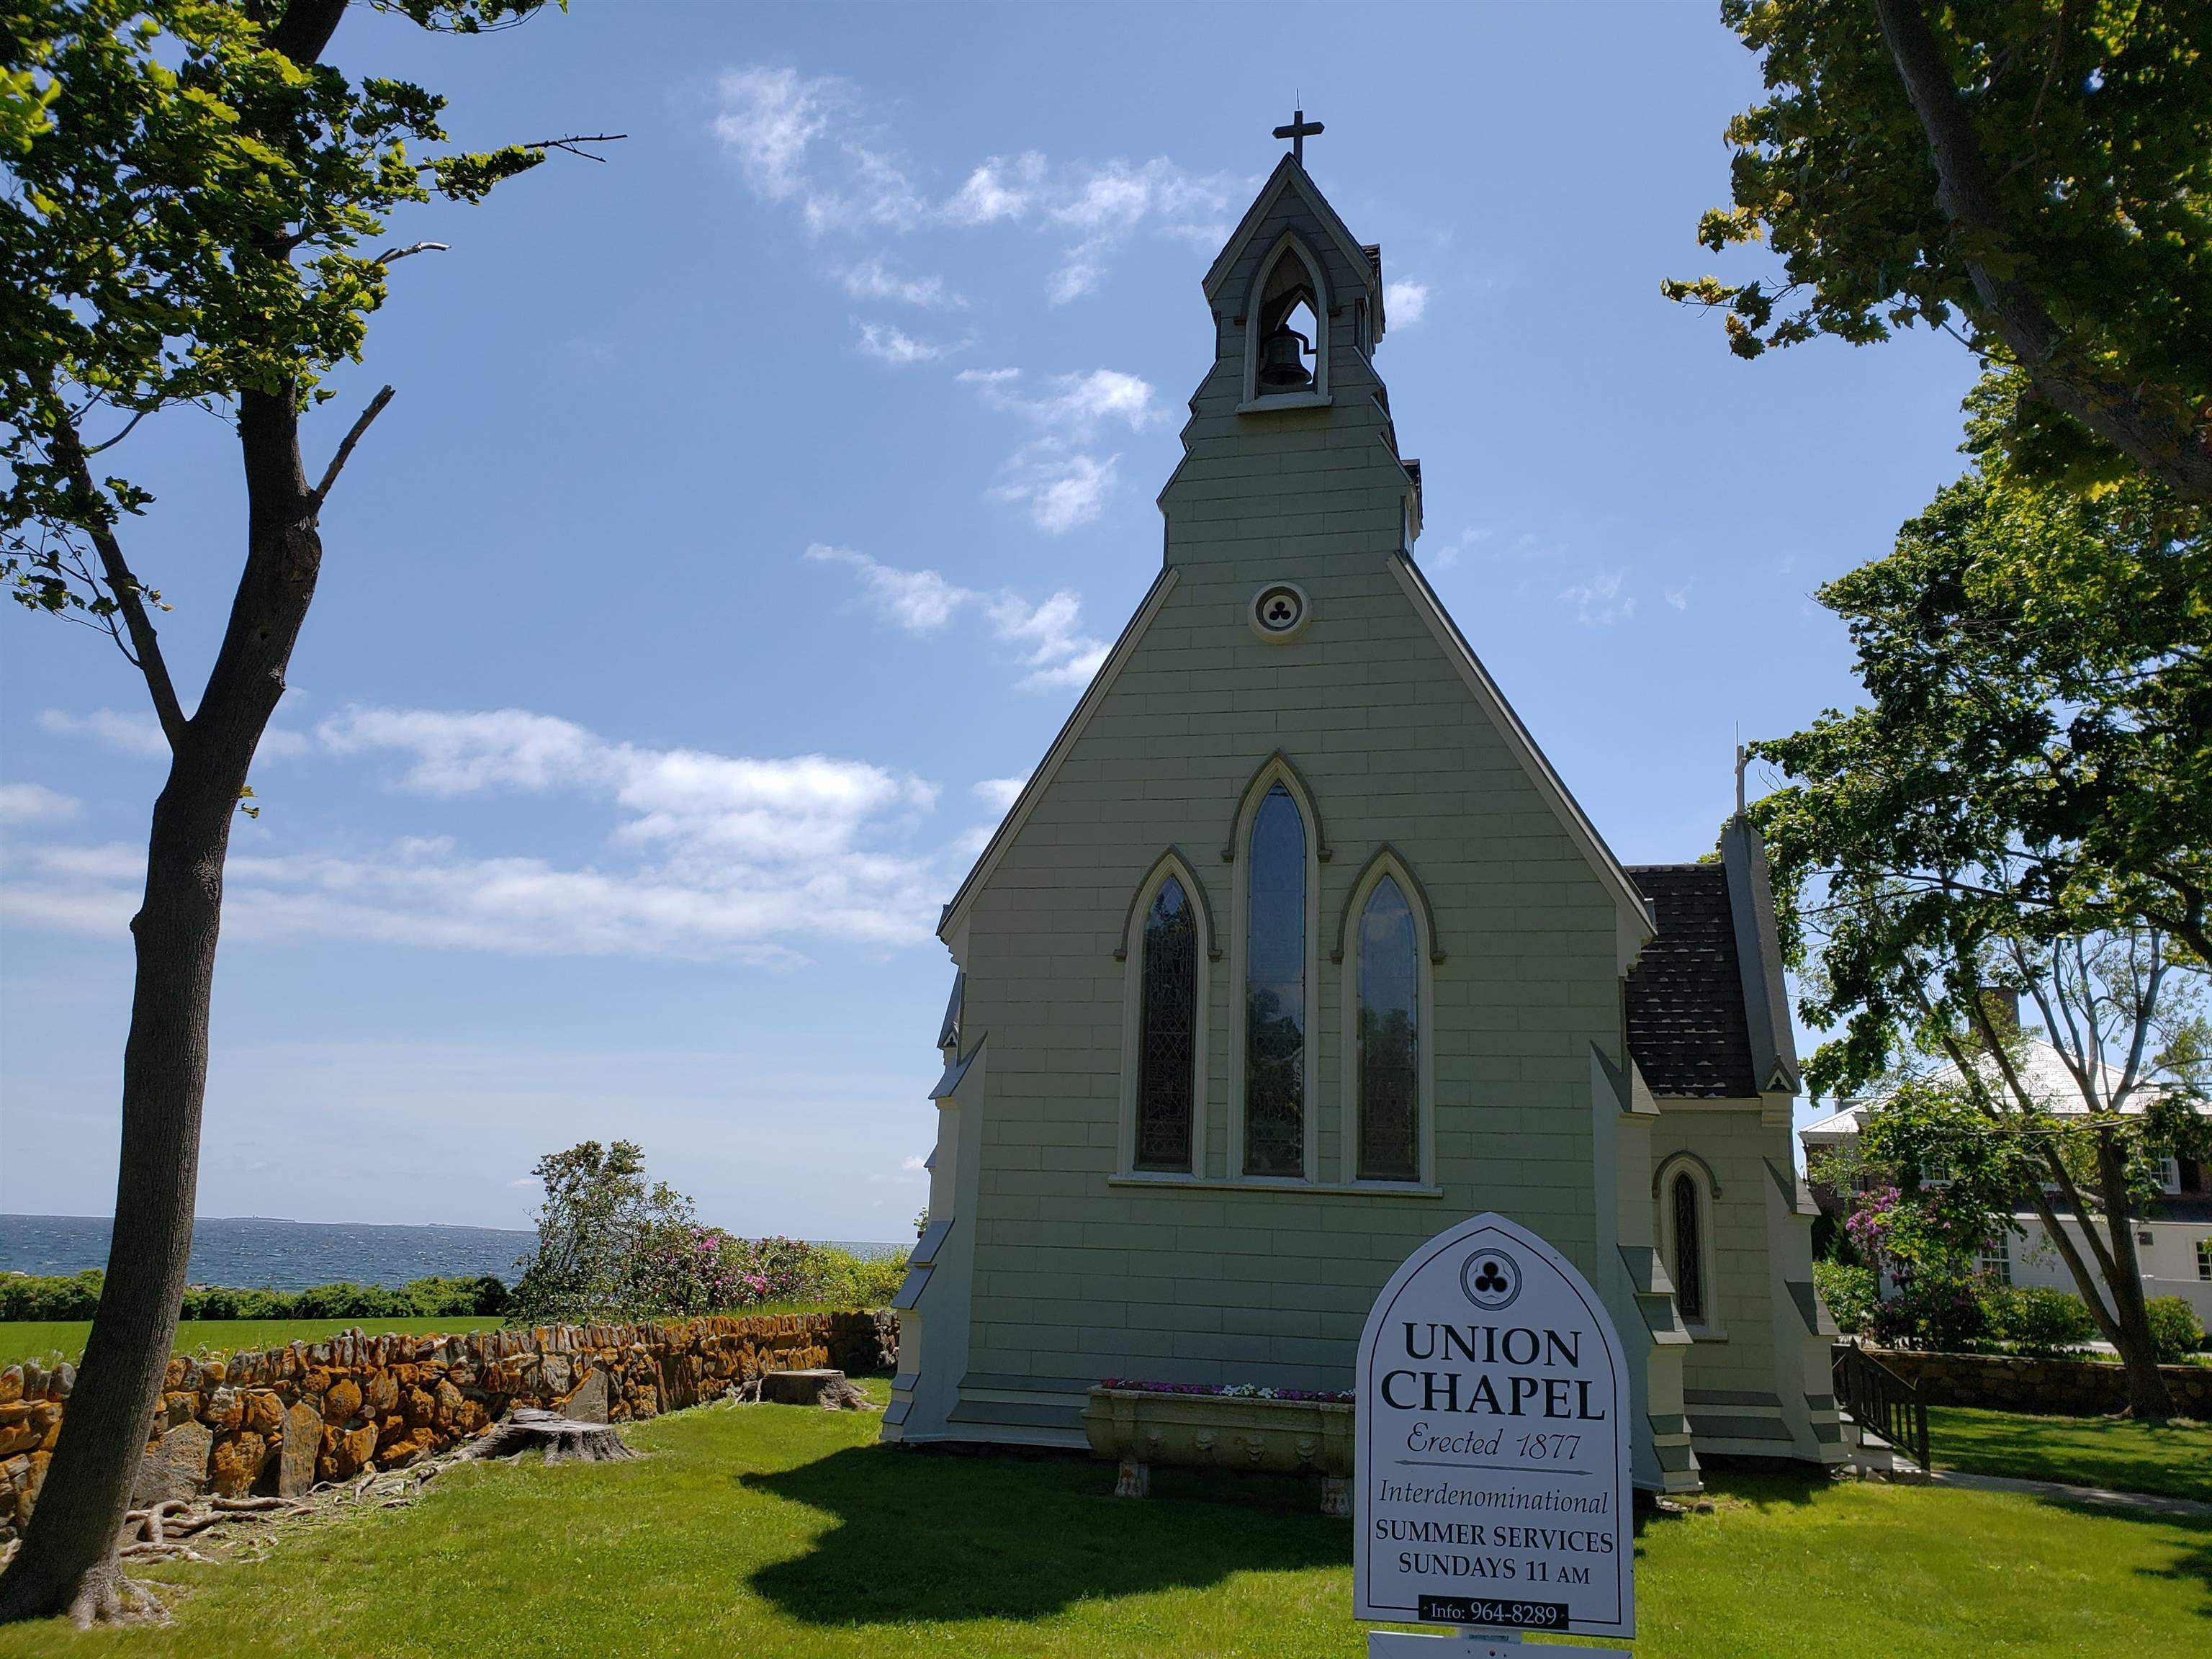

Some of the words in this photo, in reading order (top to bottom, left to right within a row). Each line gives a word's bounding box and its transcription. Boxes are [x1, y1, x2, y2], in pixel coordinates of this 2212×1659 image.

[1401, 1322, 1582, 1368] UNION
[1381, 1370, 1606, 1421] CHAPEL
[1407, 1421, 1504, 1456] Erected
[1516, 1431, 1581, 1460] 1877
[1378, 1479, 1609, 1514] Interdenominational
[1375, 1519, 1486, 1546] SUMMER
[1493, 1526, 1614, 1553] SERVICES
[1398, 1552, 1516, 1578] SUNDAYS
[1526, 1560, 1550, 1581] 11
[1557, 1565, 1590, 1585] AM
[1431, 1603, 1465, 1619] Info:
[1470, 1601, 1557, 1624] 964-8289
